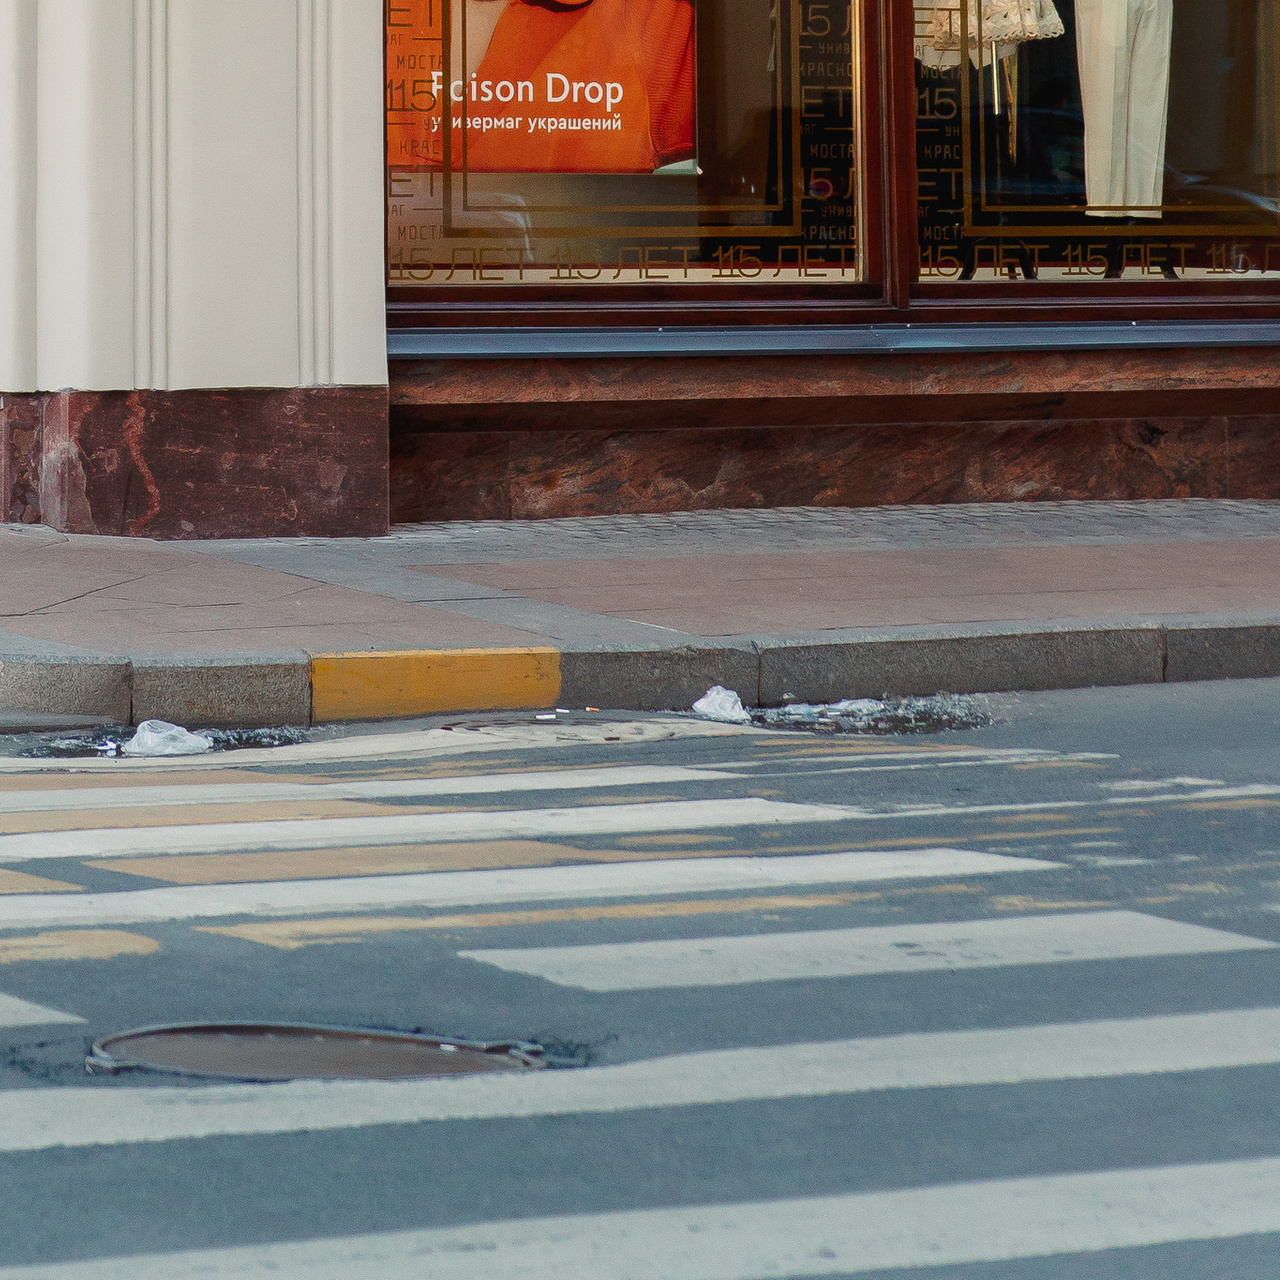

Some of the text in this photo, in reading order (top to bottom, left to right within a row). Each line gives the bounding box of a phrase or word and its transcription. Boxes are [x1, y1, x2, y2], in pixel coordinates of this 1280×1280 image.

[387, 79, 437, 113] 115
[546, 72, 624, 113] Drop
[431, 113, 622, 134] уивермаг украшений
[612, 246, 699, 280] ЛЕТ
[712, 244, 763, 278] 115
[773, 244, 857, 278] ЛЕТ
[1061, 244, 1110, 276] 115
